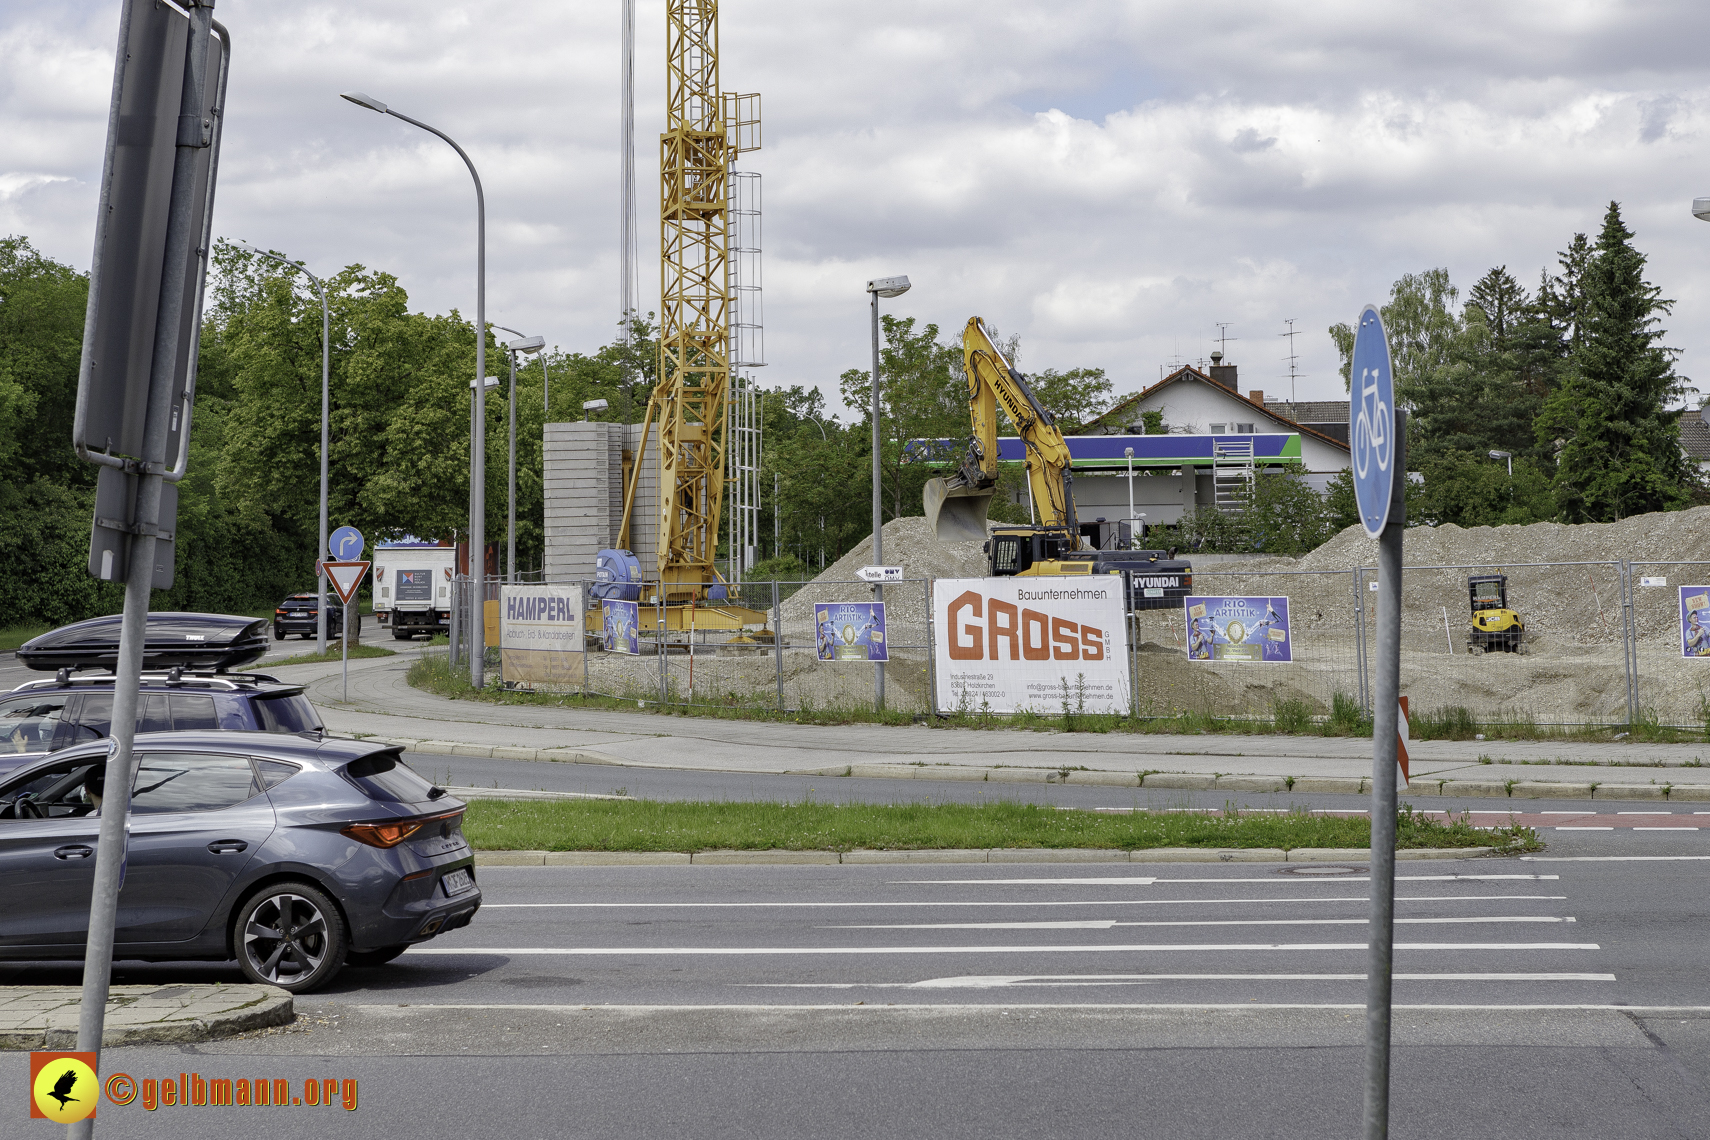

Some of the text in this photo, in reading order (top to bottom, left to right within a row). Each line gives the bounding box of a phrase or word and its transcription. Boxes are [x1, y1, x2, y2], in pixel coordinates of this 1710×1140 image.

[994, 380, 1023, 422] HYUNDA
[1133, 577, 1179, 588] HYUNDAI
[1018, 589, 1107, 600] Bauunternehmen
[507, 596, 575, 621] HAMPERL
[1224, 600, 1246, 608] RIO
[840, 605, 856, 613] RIO
[1214, 609, 1256, 617] ARTISTIK
[834, 613, 863, 621] ARTISTIK
[947, 590, 1104, 661] GROSS
[538, 630, 542, 639] &
[543, 630, 575, 640] Kanalarbeiten
[1027, 683, 1113, 691] info@gross-bauntenehmen.de
[1028, 692, 1114, 700] www.gross-bauntenehmen.de
